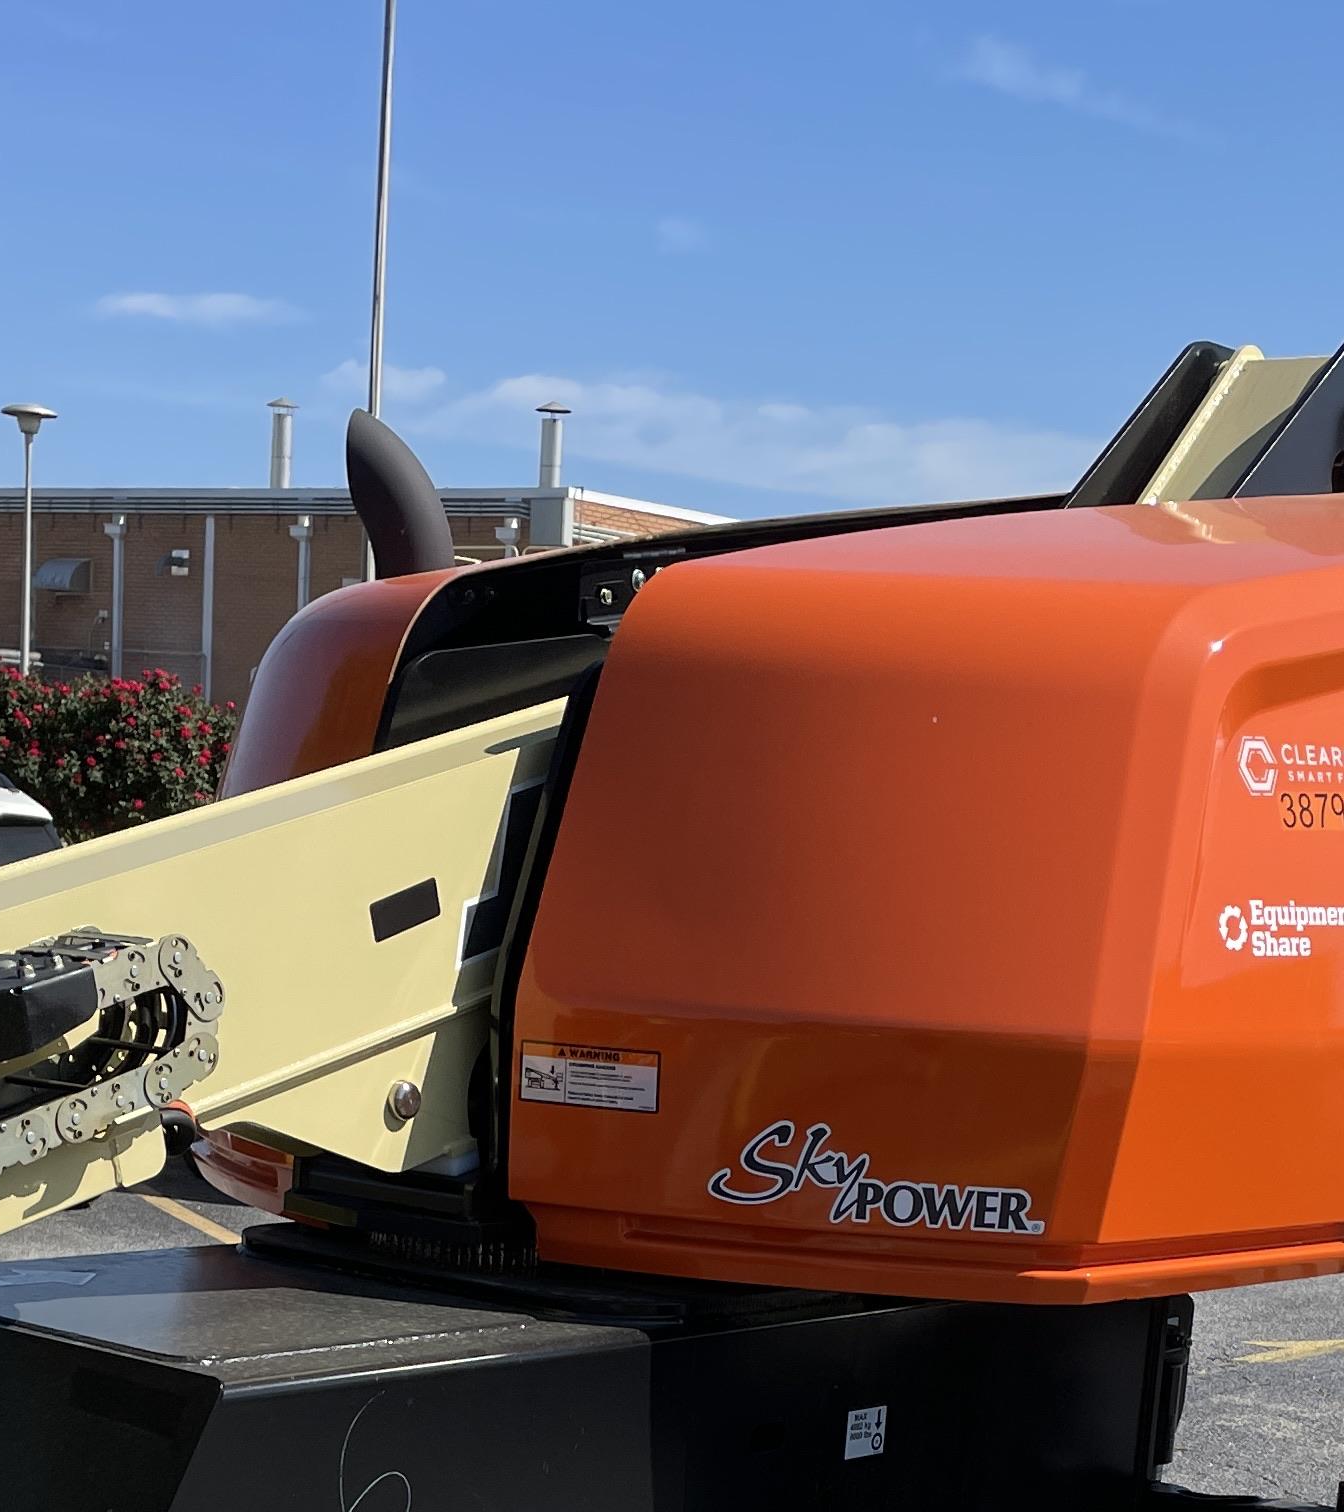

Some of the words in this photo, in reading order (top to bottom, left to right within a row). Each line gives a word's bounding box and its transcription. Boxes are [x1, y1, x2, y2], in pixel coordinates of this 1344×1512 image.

[1288, 770, 1333, 783] SMART
[1251, 930, 1312, 957] Share
[569, 1049, 621, 1062] WARNING
[709, 1121, 868, 1221] Sky
[854, 1181, 1030, 1232] POWER
